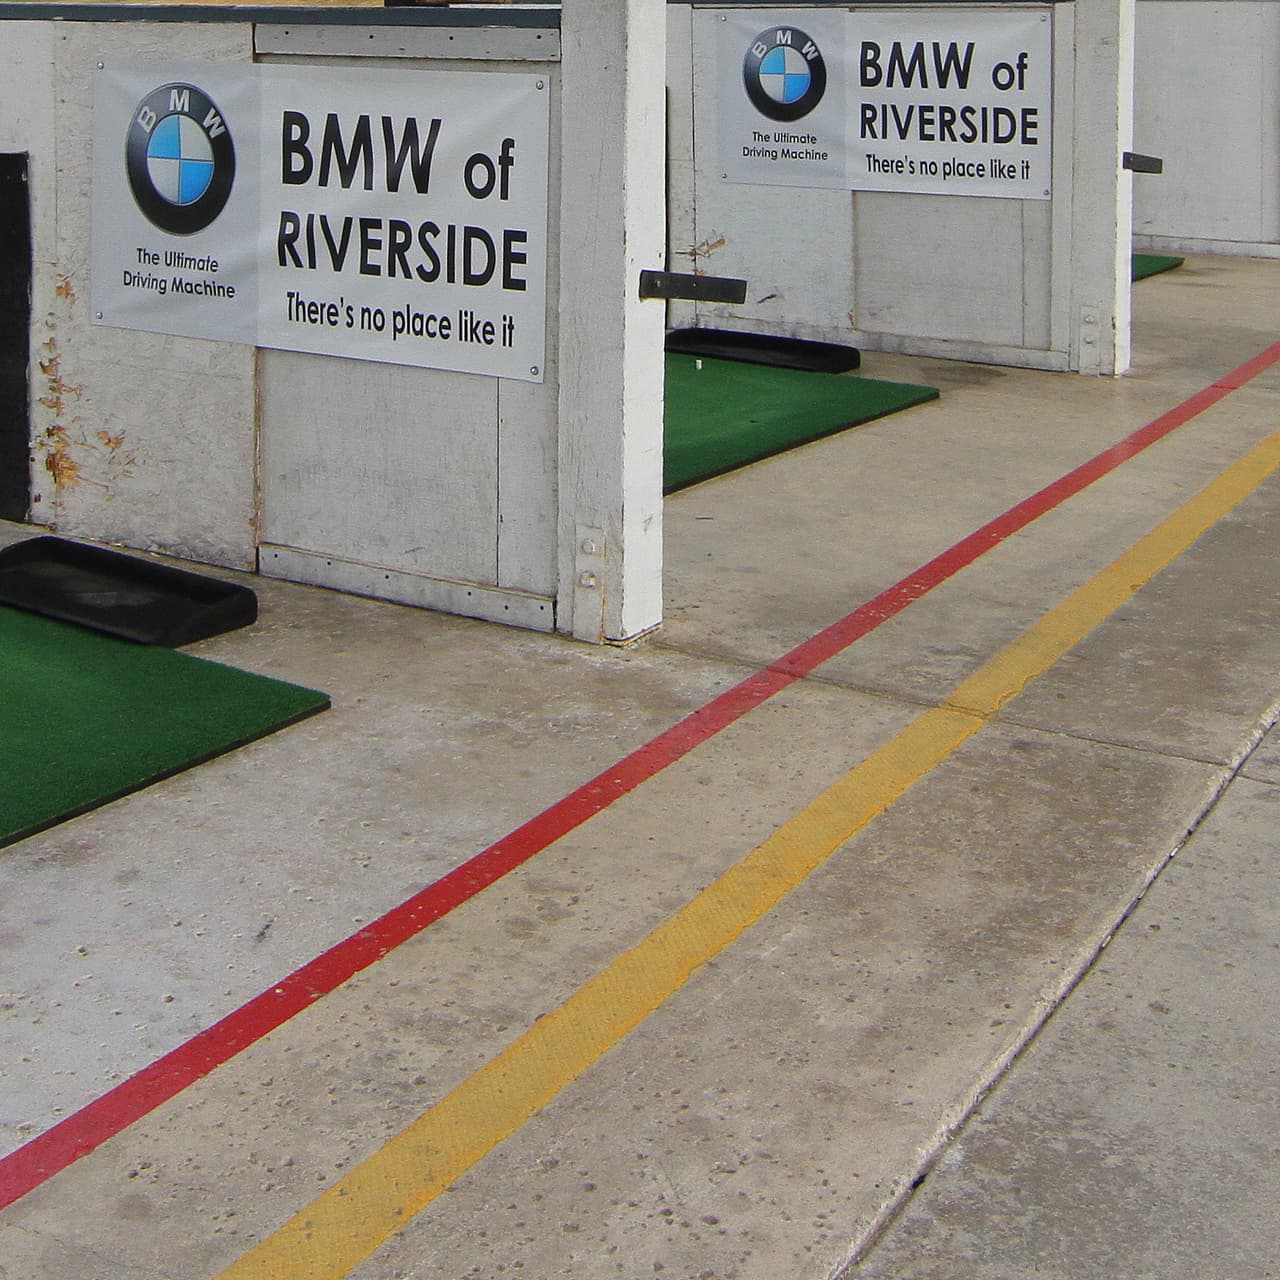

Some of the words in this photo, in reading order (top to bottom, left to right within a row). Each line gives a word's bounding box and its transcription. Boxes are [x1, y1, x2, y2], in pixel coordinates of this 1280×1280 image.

[751, 29, 820, 62] BMW
[859, 41, 975, 91] BMW
[992, 52, 1028, 92] of
[136, 88, 226, 141] BMW
[859, 103, 1039, 145] RIVERSIDE
[281, 110, 442, 195] BMW
[463, 137, 516, 201] of
[742, 147, 778, 162] Driving
[780, 148, 828, 161] Machine
[752, 131, 770, 144] The
[773, 131, 817, 145] Ultimate
[866, 153, 915, 176] There's
[919, 161, 938, 177] no
[942, 158, 985, 181] place
[989, 158, 1017, 180] like
[1020, 160, 1031, 181] it
[136, 247, 161, 267] The
[164, 250, 219, 274] Ultimate
[277, 211, 529, 292] RIVERSIDE
[122, 270, 169, 296] Driving
[171, 276, 236, 300] Machine
[286, 291, 355, 331] There's
[360, 304, 386, 334] no
[392, 303, 452, 342] place
[457, 310, 496, 346] like
[500, 314, 515, 349] it
